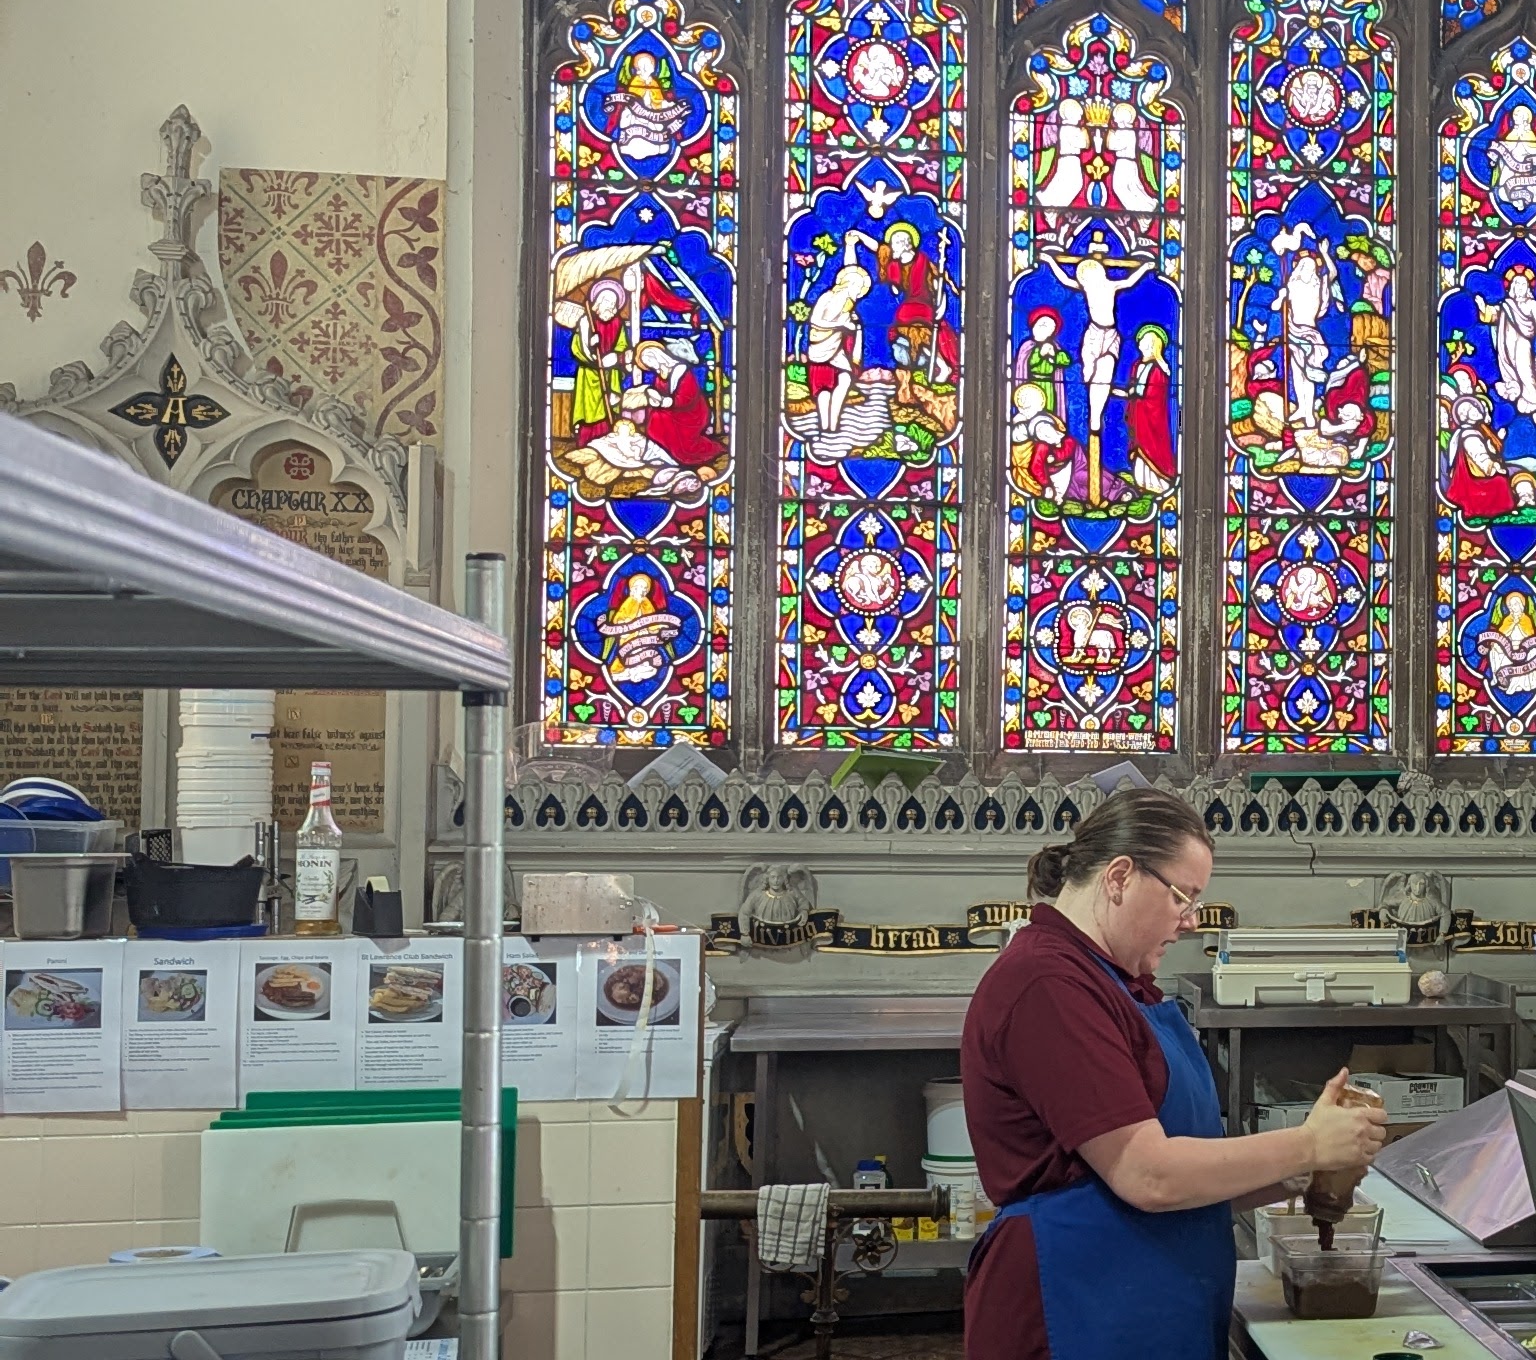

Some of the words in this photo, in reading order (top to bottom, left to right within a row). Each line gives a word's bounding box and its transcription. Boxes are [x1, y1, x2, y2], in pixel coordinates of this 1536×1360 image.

[161, 397, 187, 424] A
[330, 492, 373, 513] XX
[870, 924, 941, 948] bread
[153, 957, 195, 966] Sandwich
